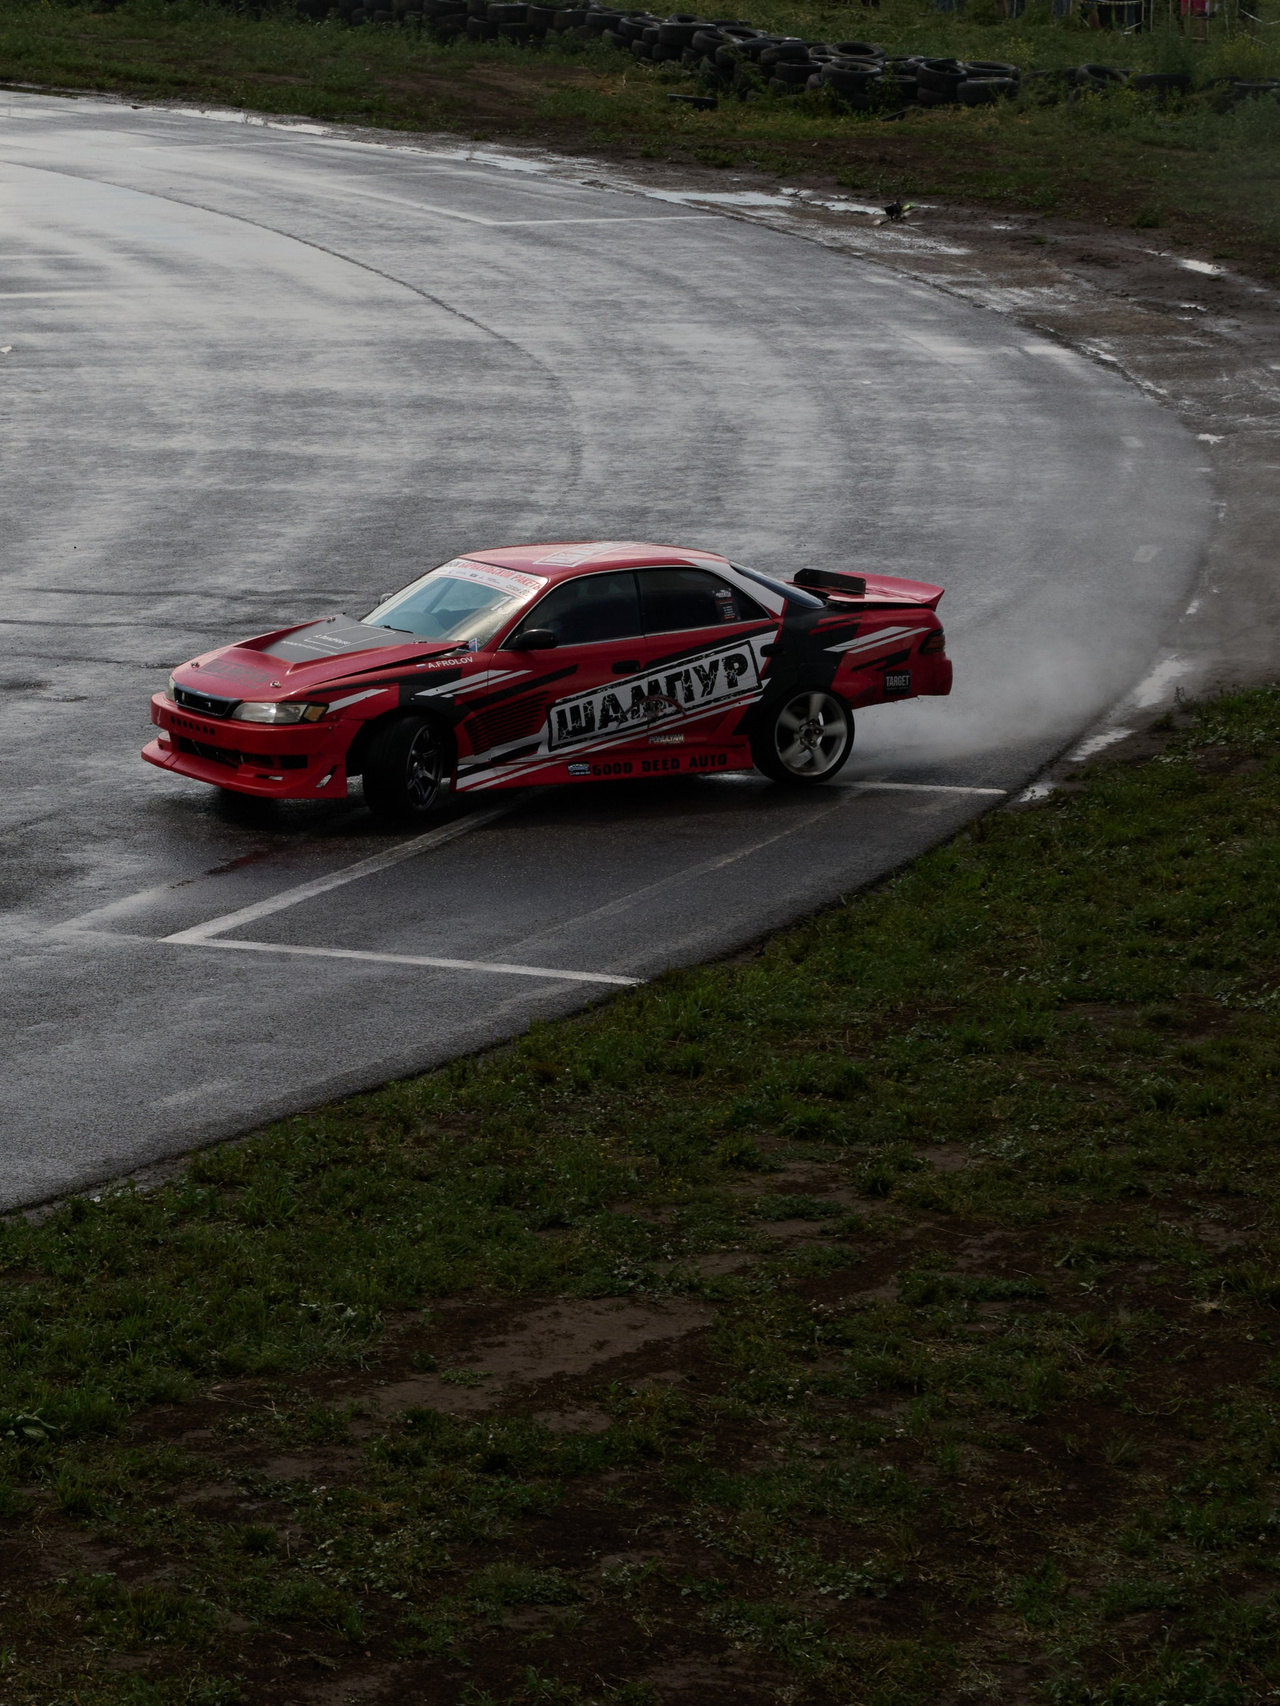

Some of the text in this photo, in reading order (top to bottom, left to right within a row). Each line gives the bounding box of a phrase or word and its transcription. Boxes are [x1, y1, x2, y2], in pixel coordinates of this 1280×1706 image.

[428, 656, 473, 669] A.FROLOV
[886, 675, 910, 687] TARGET
[556, 653, 749, 741] ШАМПУР
[592, 754, 727, 776] GOOD DEED AUTO
